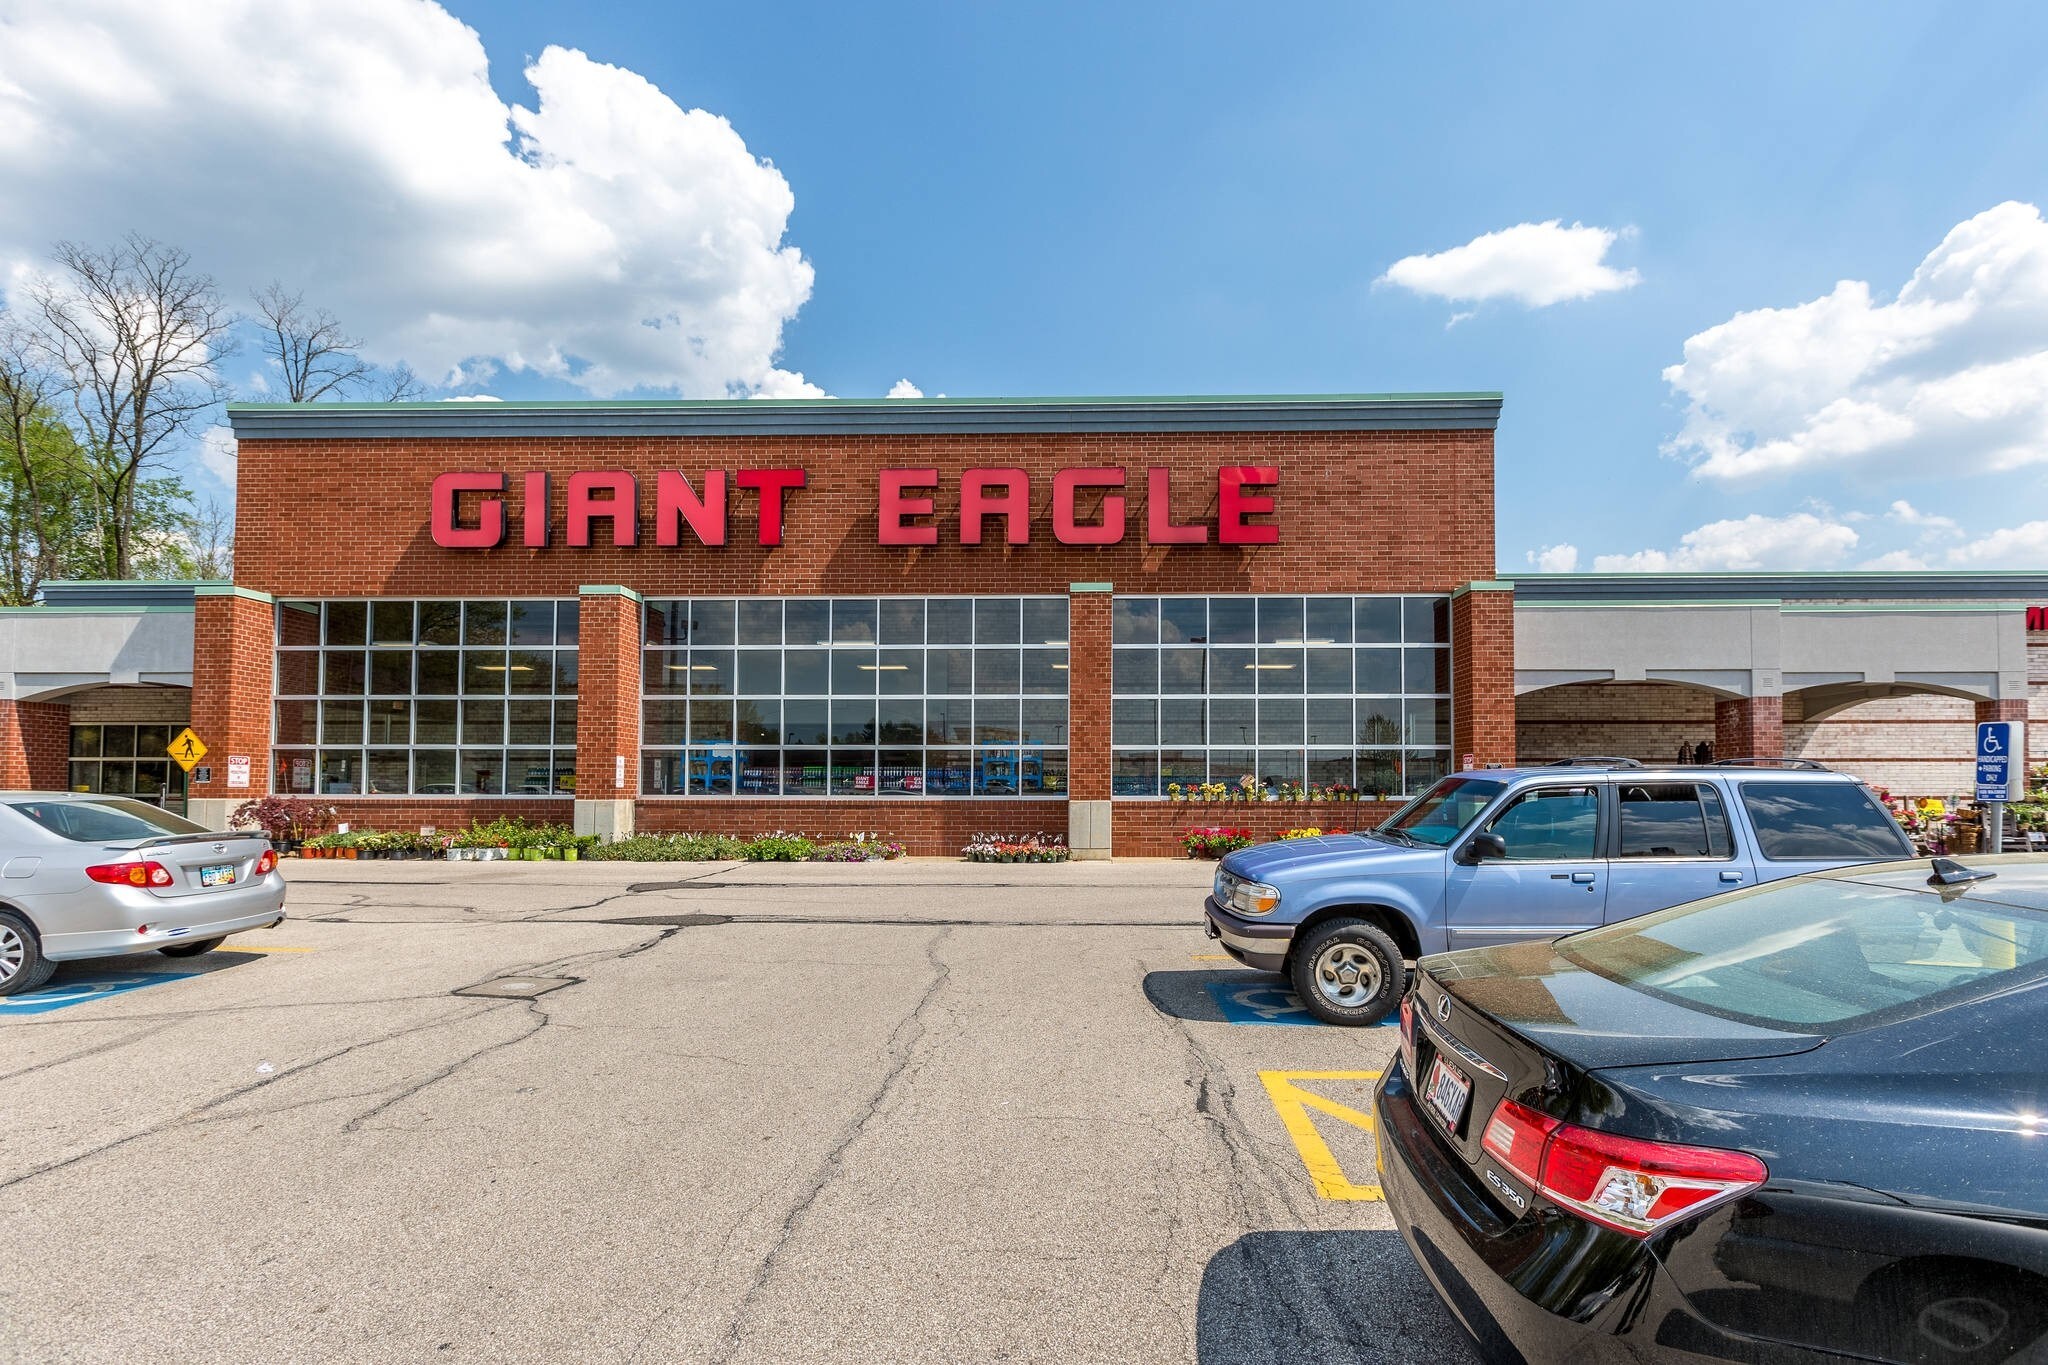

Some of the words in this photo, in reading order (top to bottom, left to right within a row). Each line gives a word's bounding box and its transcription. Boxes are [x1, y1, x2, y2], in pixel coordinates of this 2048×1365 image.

[431, 468, 807, 548] GIANT
[878, 466, 1279, 545] EAGLE
[230, 757, 249, 765] STOP
[1978, 755, 2008, 763] HANDICAPPED
[1486, 1169, 1501, 1188] ES
[1501, 1182, 1525, 1209] 350
